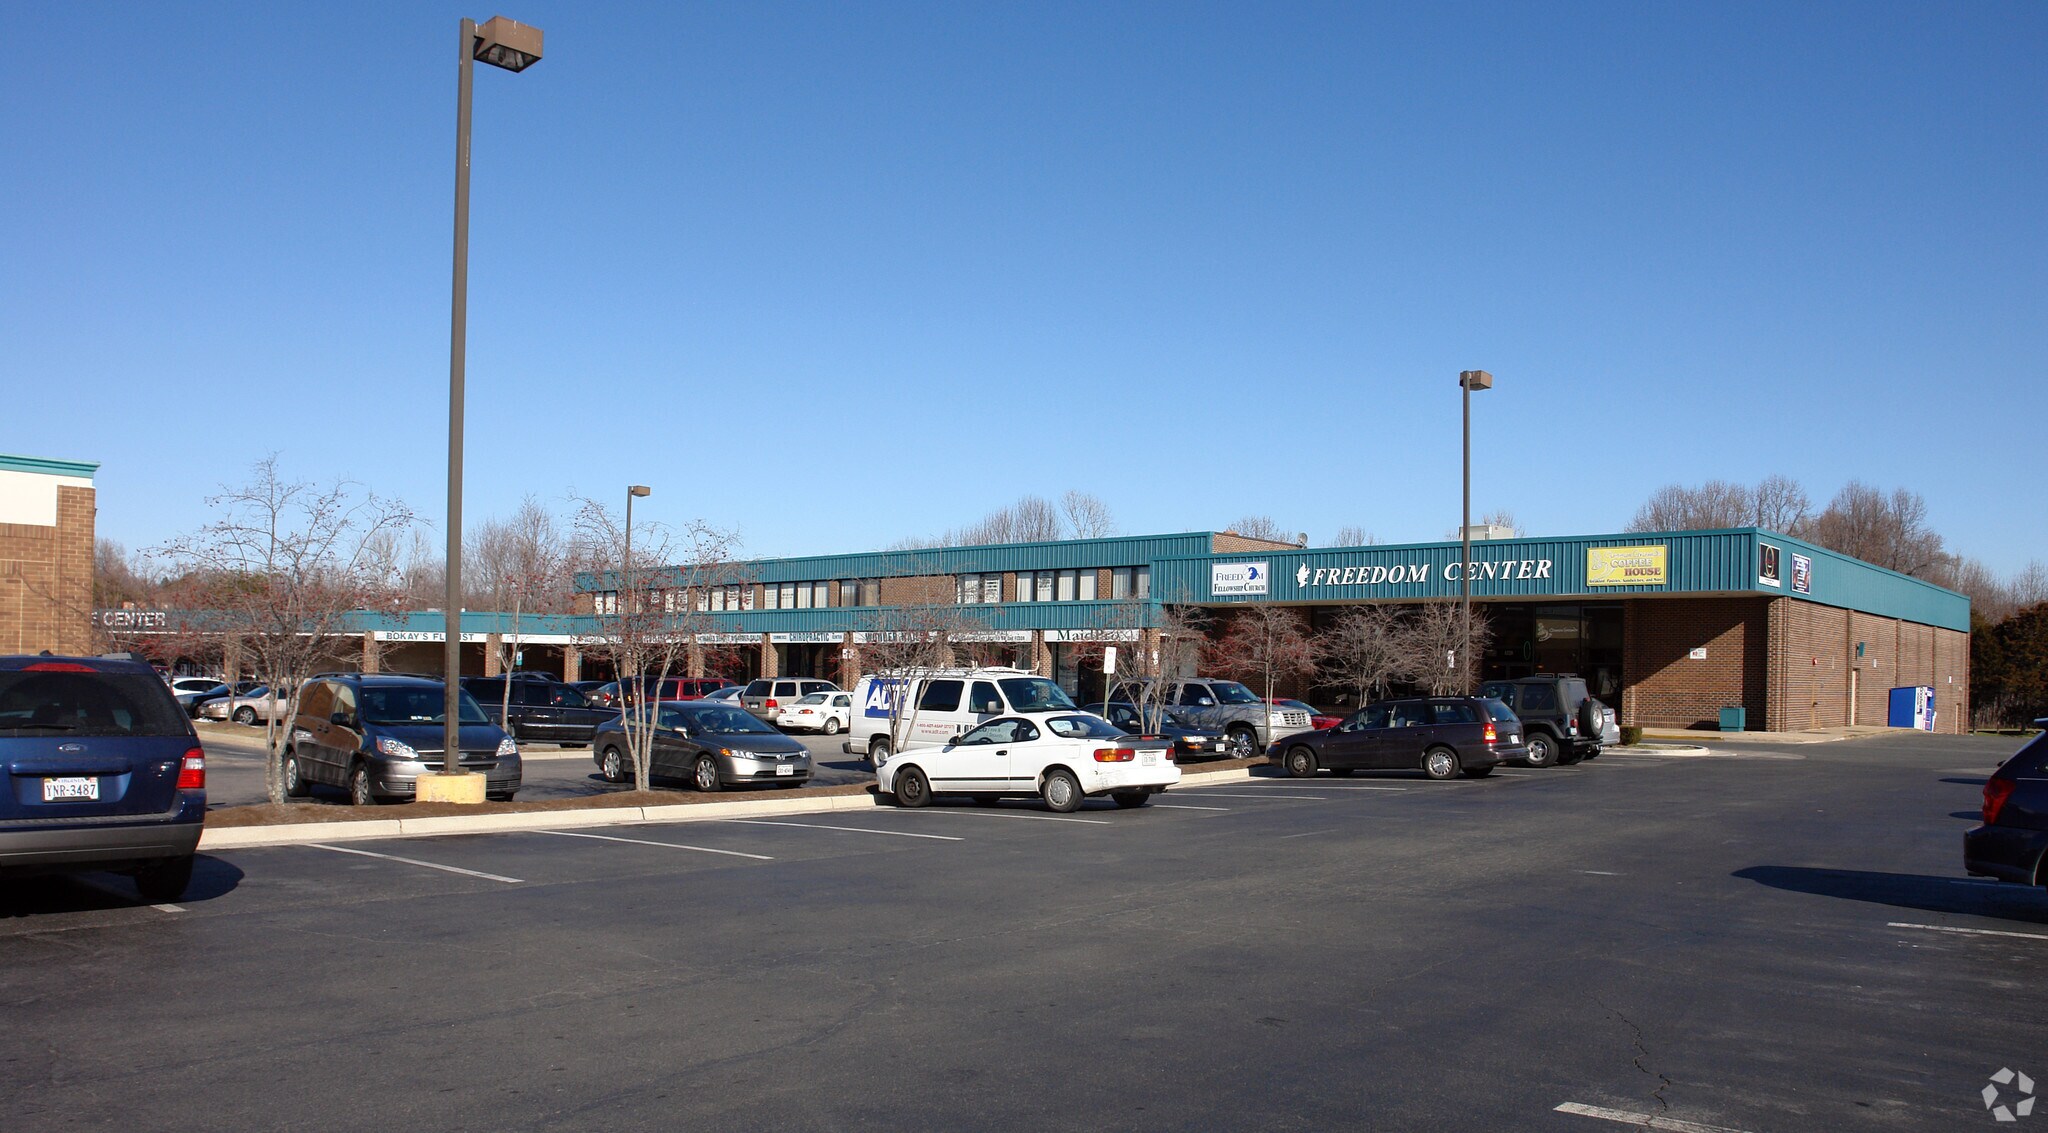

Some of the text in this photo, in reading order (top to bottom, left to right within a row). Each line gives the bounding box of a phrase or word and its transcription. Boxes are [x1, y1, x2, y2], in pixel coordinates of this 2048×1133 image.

[1611, 559, 1652, 568] COFFEE
[1311, 559, 1553, 586] FREEDOM CENTER
[1624, 568, 1661, 576] HOUSE
[103, 611, 166, 626] CENTER
[386, 632, 475, 642] BOKAY'S FLIST
[789, 632, 830, 642] CHIROPRACTIC
[865, 684, 908, 710] ADT
[46, 783, 96, 797] YNR-3487
